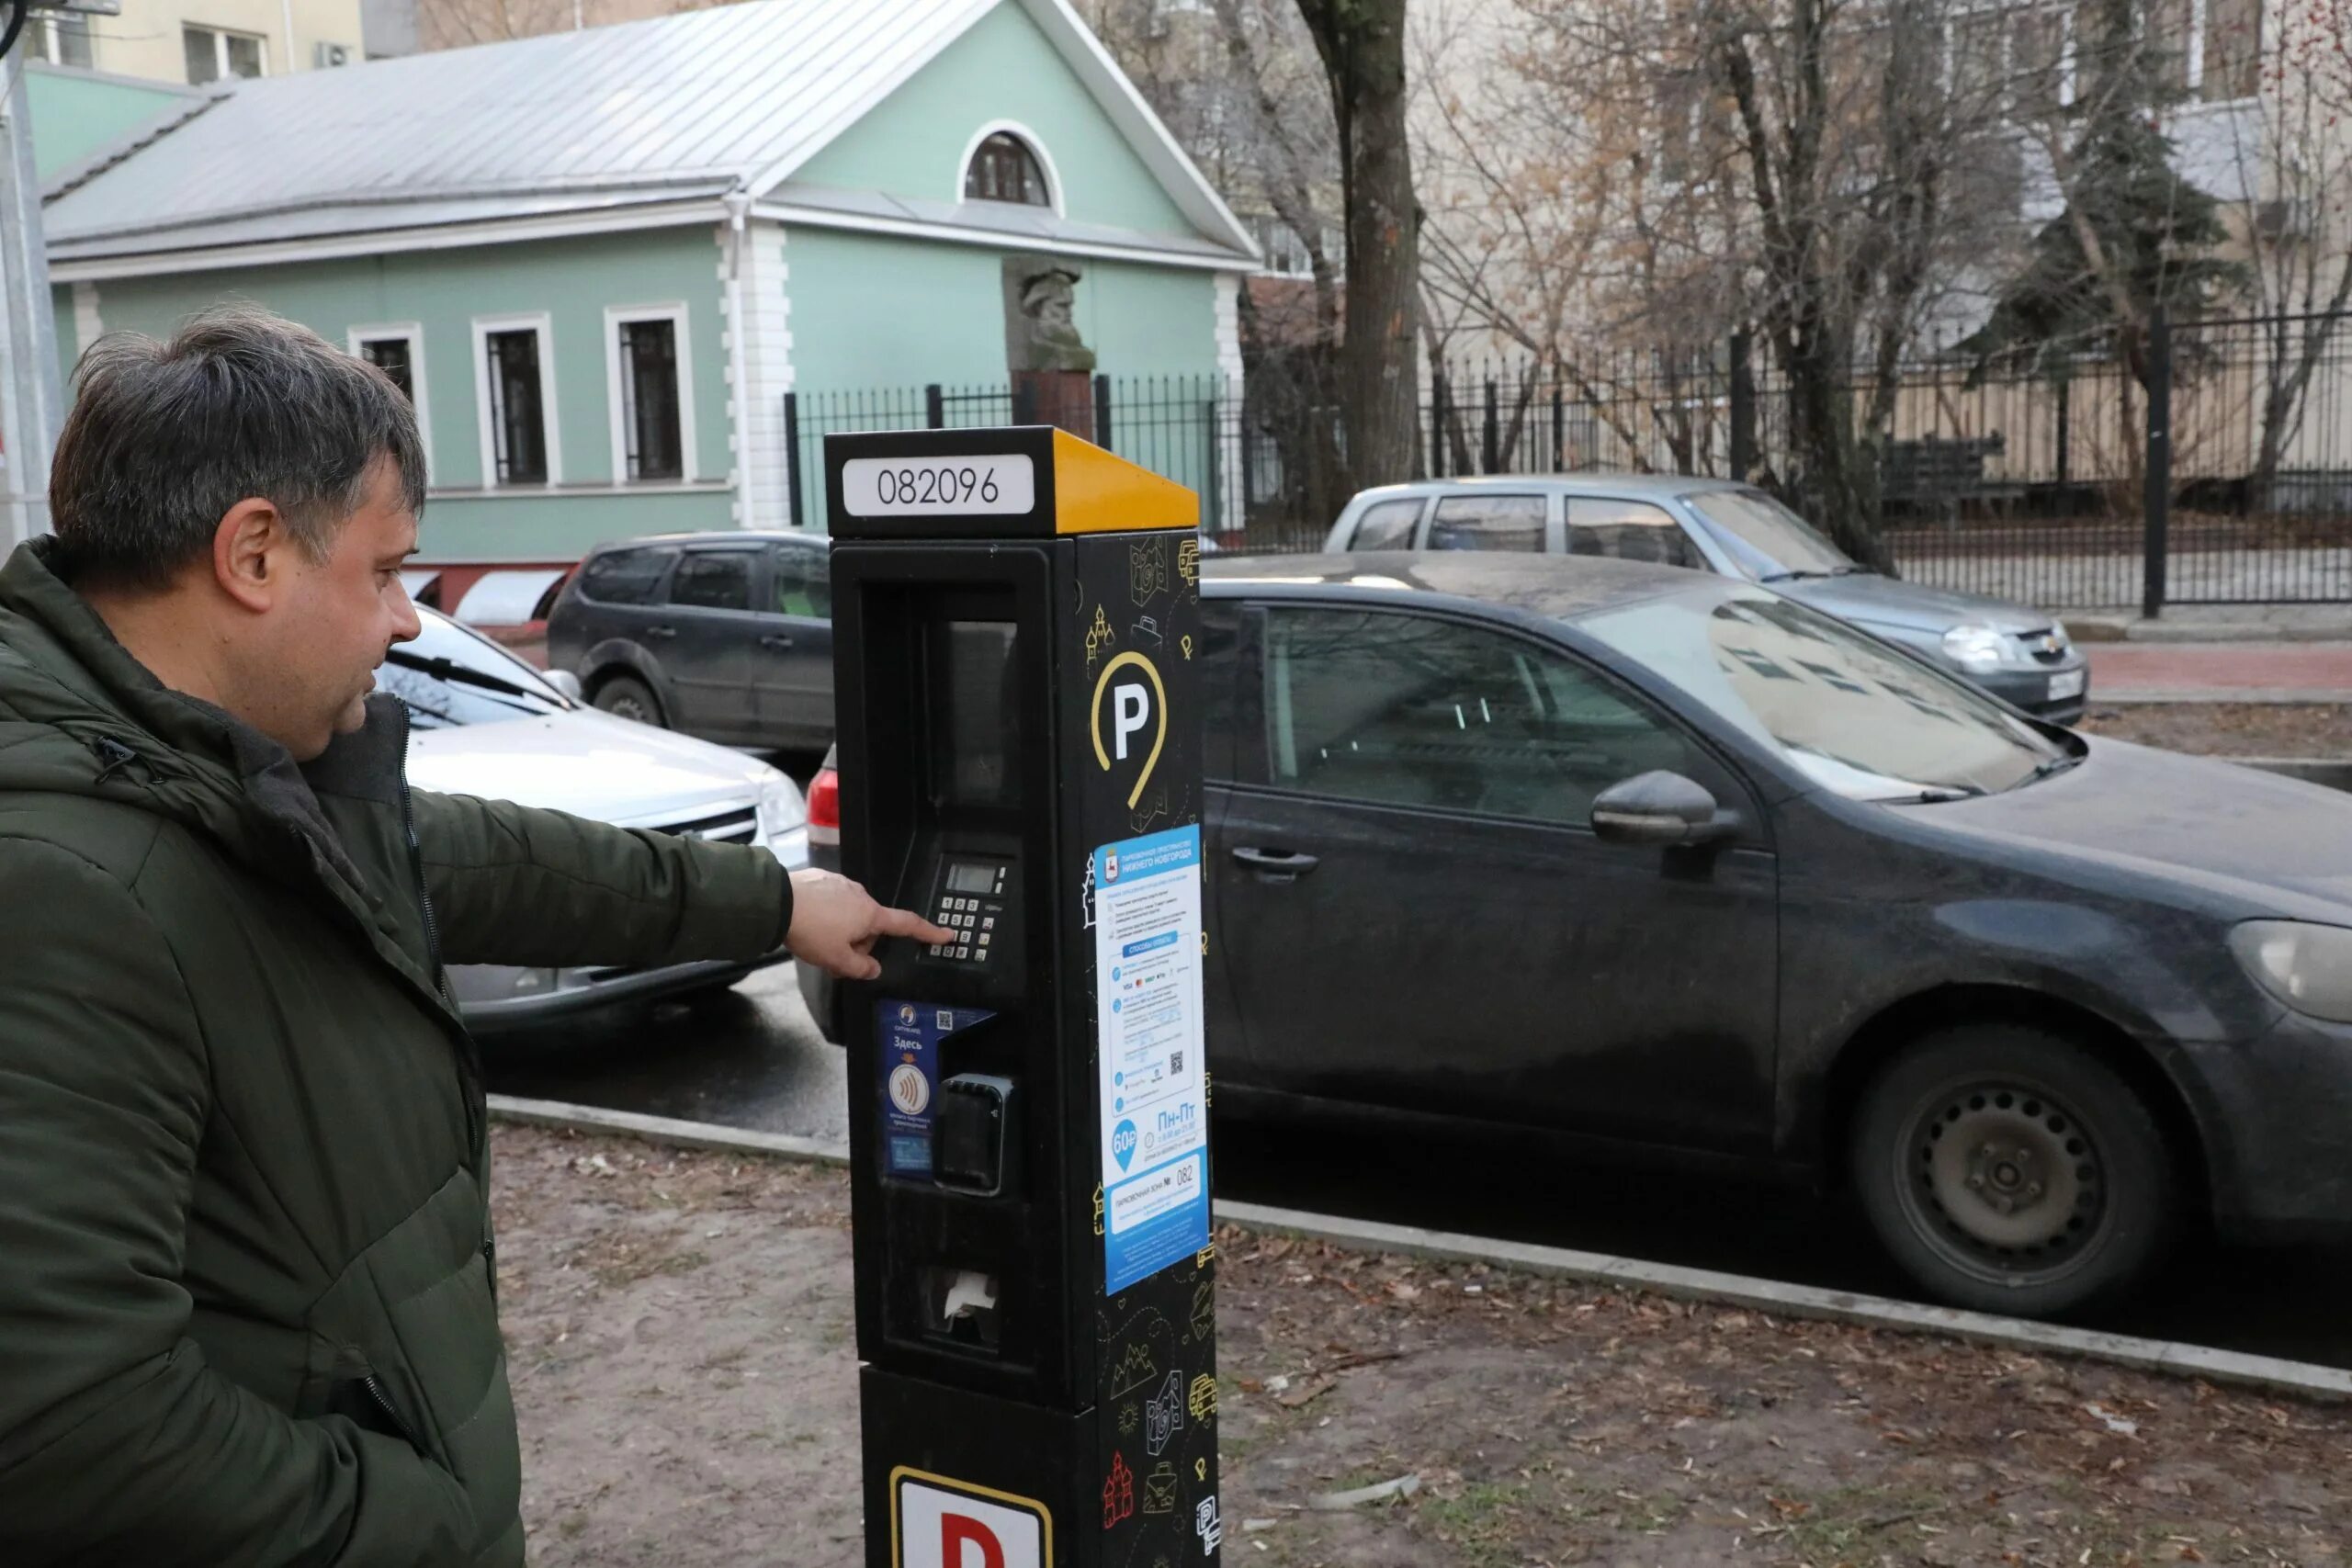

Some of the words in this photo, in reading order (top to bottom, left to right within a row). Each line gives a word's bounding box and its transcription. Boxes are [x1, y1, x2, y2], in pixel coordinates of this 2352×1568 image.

[877, 467, 999, 505] 082096
[1114, 682, 1149, 760] P
[894, 1035, 922, 1051] Здесь
[1158, 1102, 1195, 1132] Пн-Пт
[1177, 1165, 1193, 1186] 082
